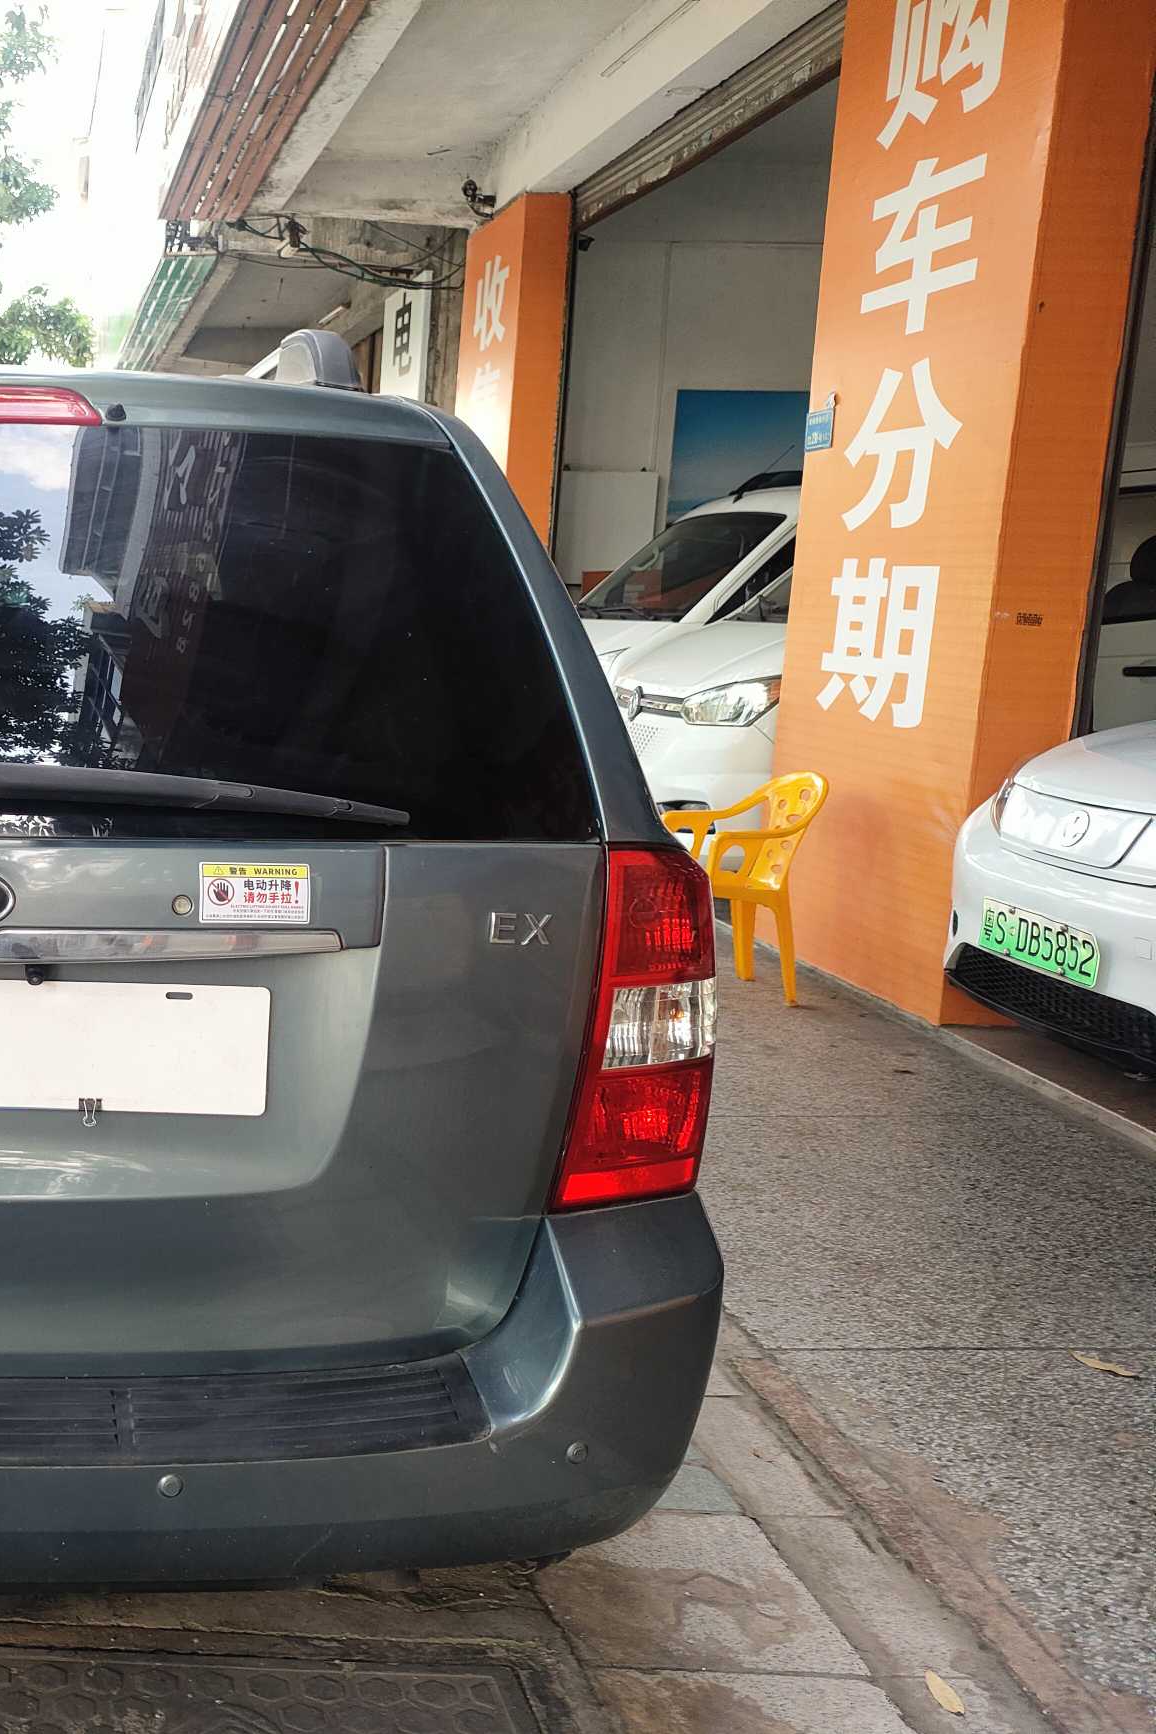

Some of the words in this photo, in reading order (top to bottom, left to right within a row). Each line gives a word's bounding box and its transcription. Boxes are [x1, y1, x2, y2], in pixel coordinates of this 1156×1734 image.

[393, 292, 412, 377] 电
[817, 0, 1009, 728] 购车分期
[229, 867, 247, 875] 警告
[253, 868, 298, 876] WARNING
[244, 879, 292, 891] 电动升降
[489, 912, 552, 945] EX
